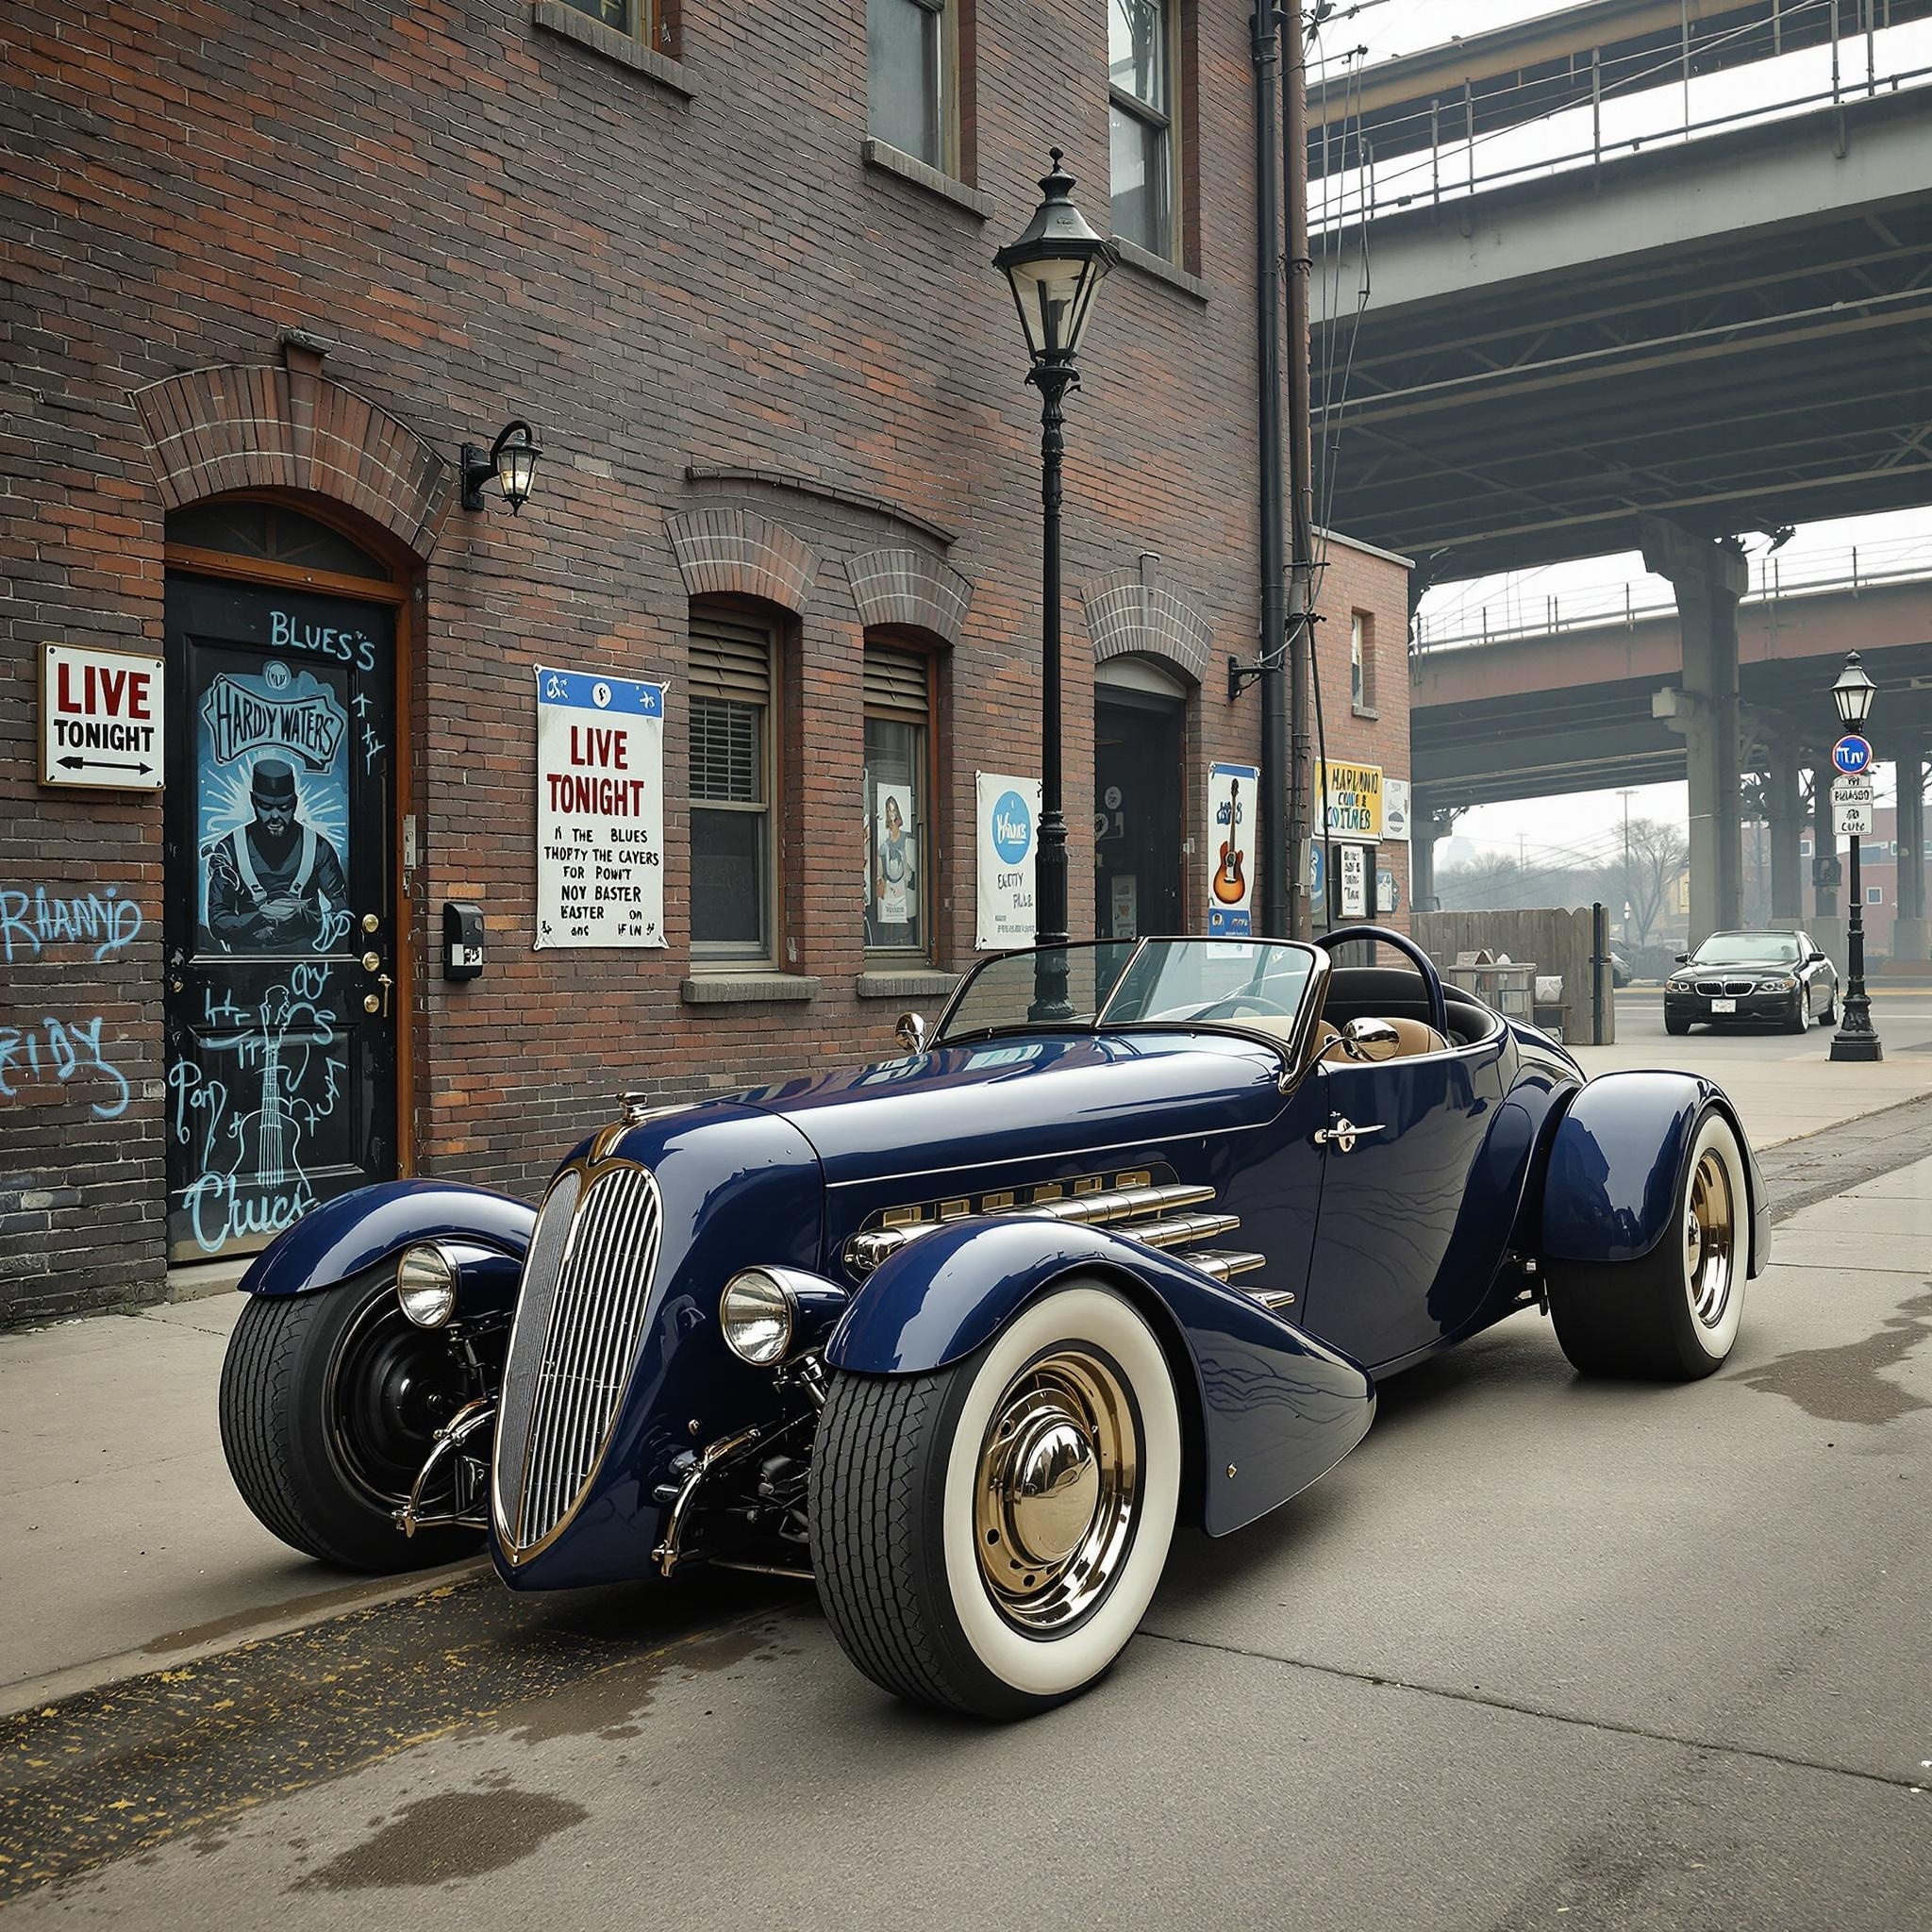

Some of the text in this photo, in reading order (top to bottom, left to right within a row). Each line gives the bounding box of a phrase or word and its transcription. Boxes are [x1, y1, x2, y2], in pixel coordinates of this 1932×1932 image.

[58, 663, 151, 720] LIVE
[54, 719, 155, 753] TONIGHT
[217, 683, 334, 758] HARDY WATERS
[571, 725, 627, 770] LIVE
[546, 774, 644, 817] TONIGHT
[572, 828, 593, 842] THE
[610, 828, 648, 842] BLUES
[563, 866, 585, 878] FOR
[592, 848, 613, 862] THE
[595, 886, 641, 902] BASTER
